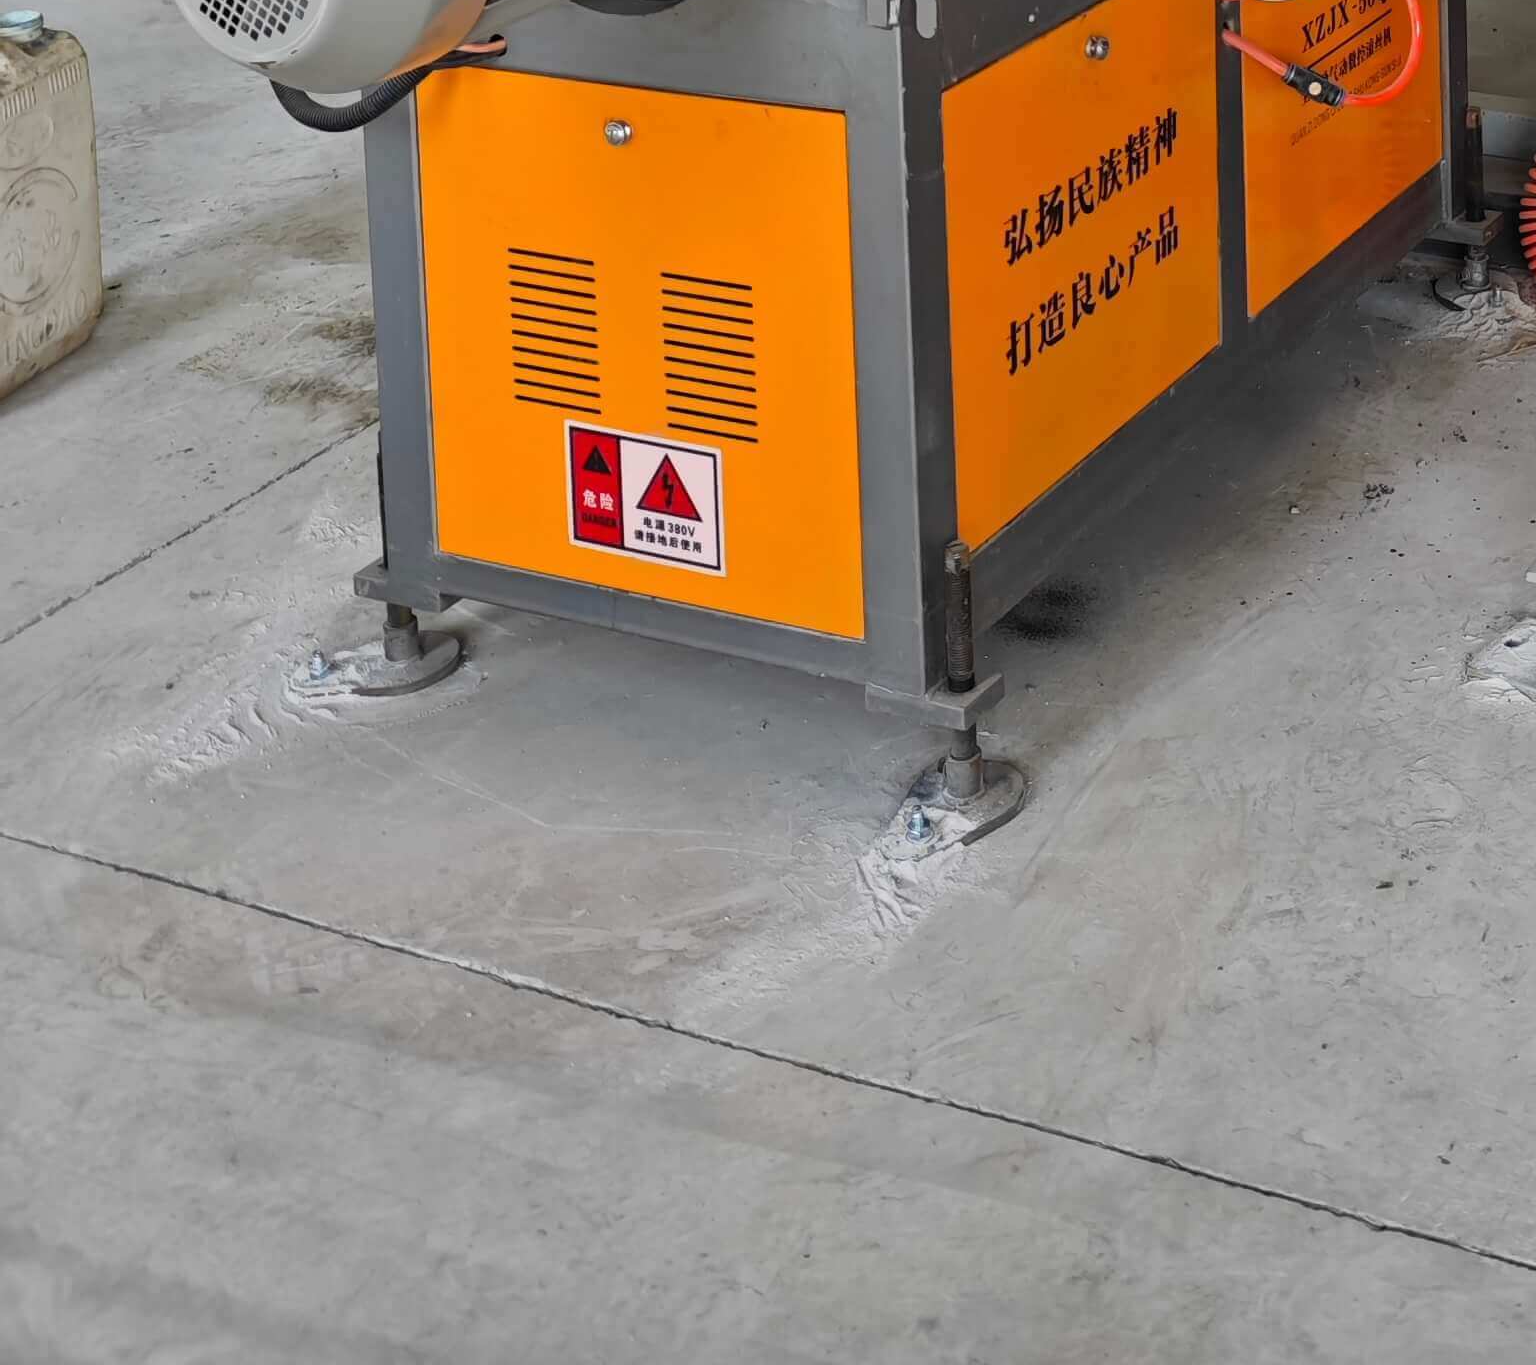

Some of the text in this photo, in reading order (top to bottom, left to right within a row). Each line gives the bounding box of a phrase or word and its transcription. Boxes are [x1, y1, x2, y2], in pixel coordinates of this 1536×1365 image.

[1003, 107, 1178, 267] 弘扬民族精神
[1005, 205, 1179, 376] 打造良心产品
[582, 488, 615, 512] 危险
